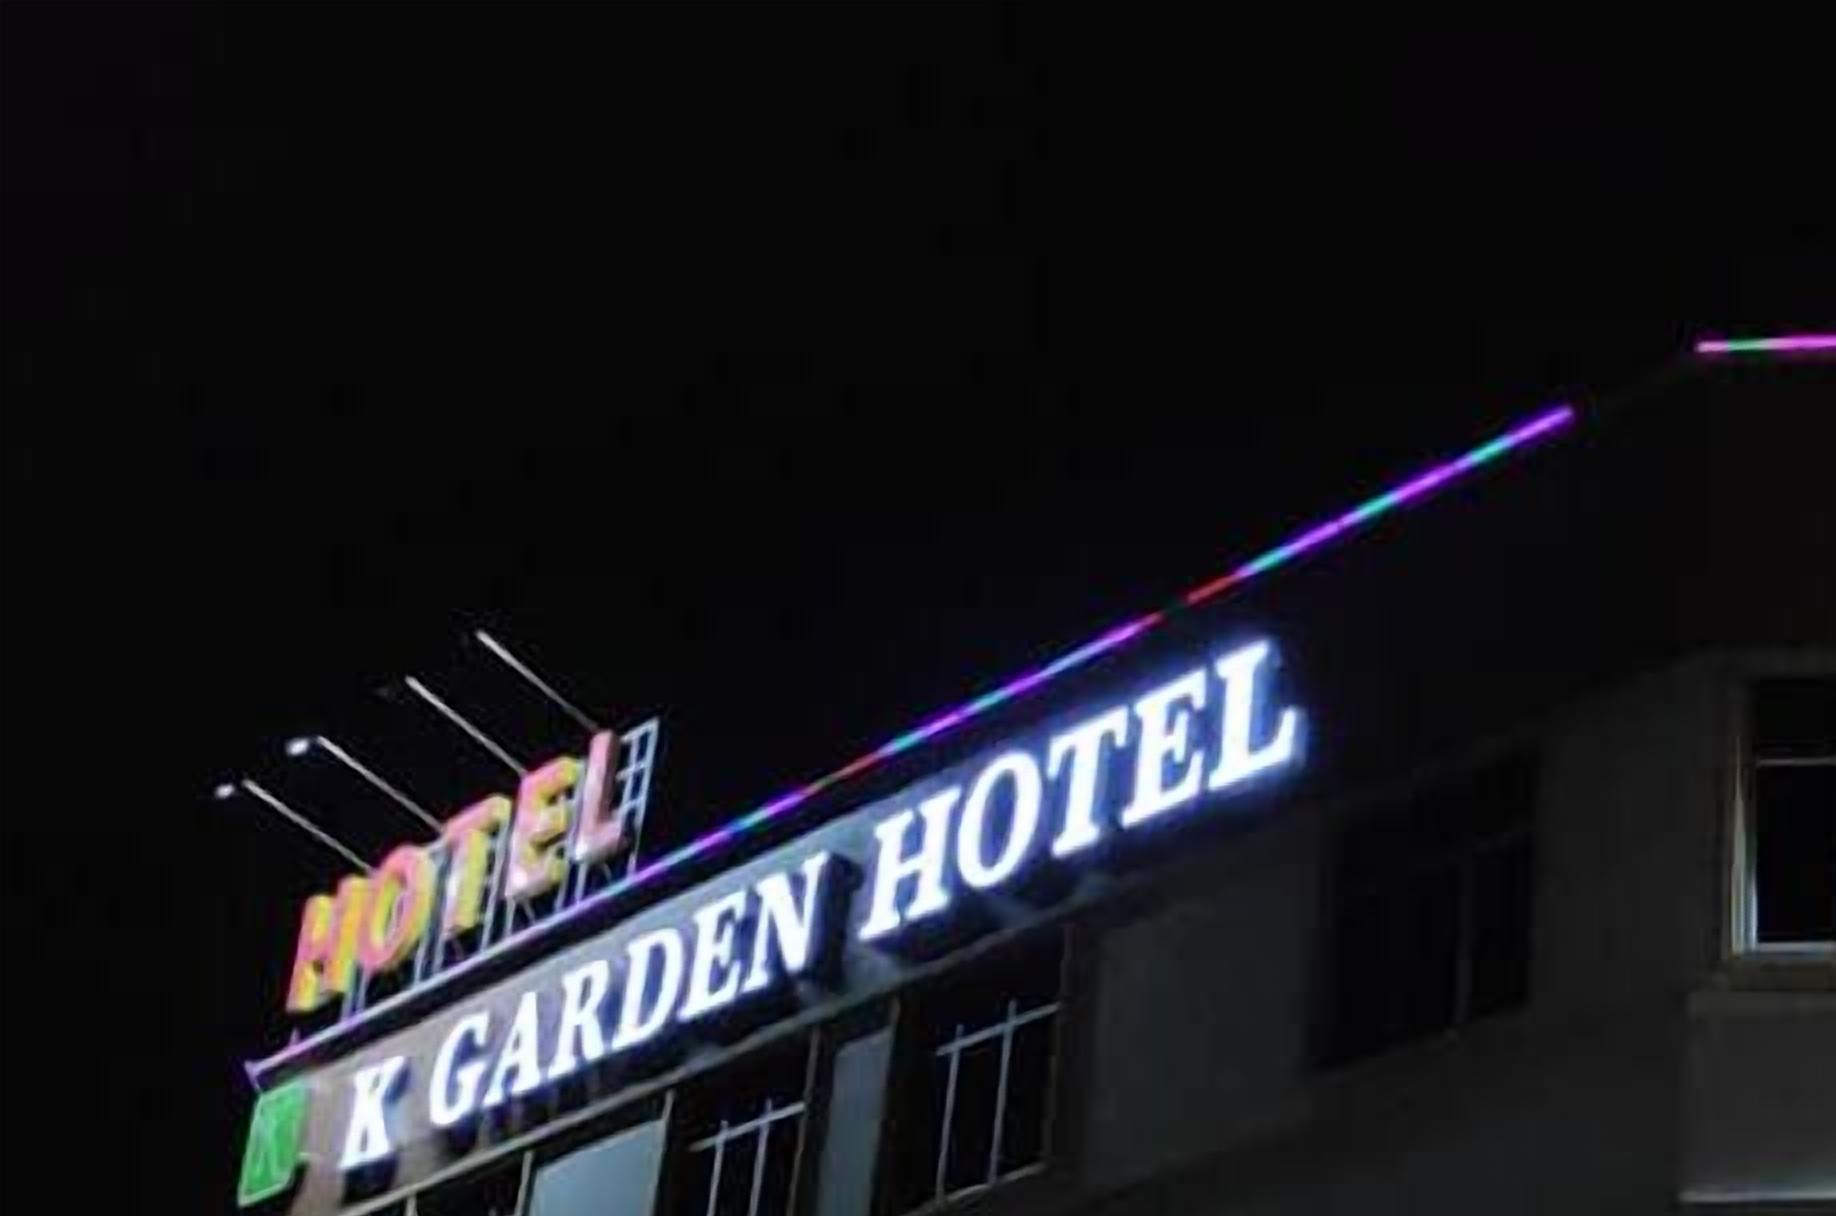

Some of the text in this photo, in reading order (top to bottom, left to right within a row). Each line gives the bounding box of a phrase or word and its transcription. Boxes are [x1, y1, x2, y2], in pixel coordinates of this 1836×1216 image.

[286, 728, 628, 1013] HOTEL
[339, 640, 1297, 1170] K GARDEN HOTEL
